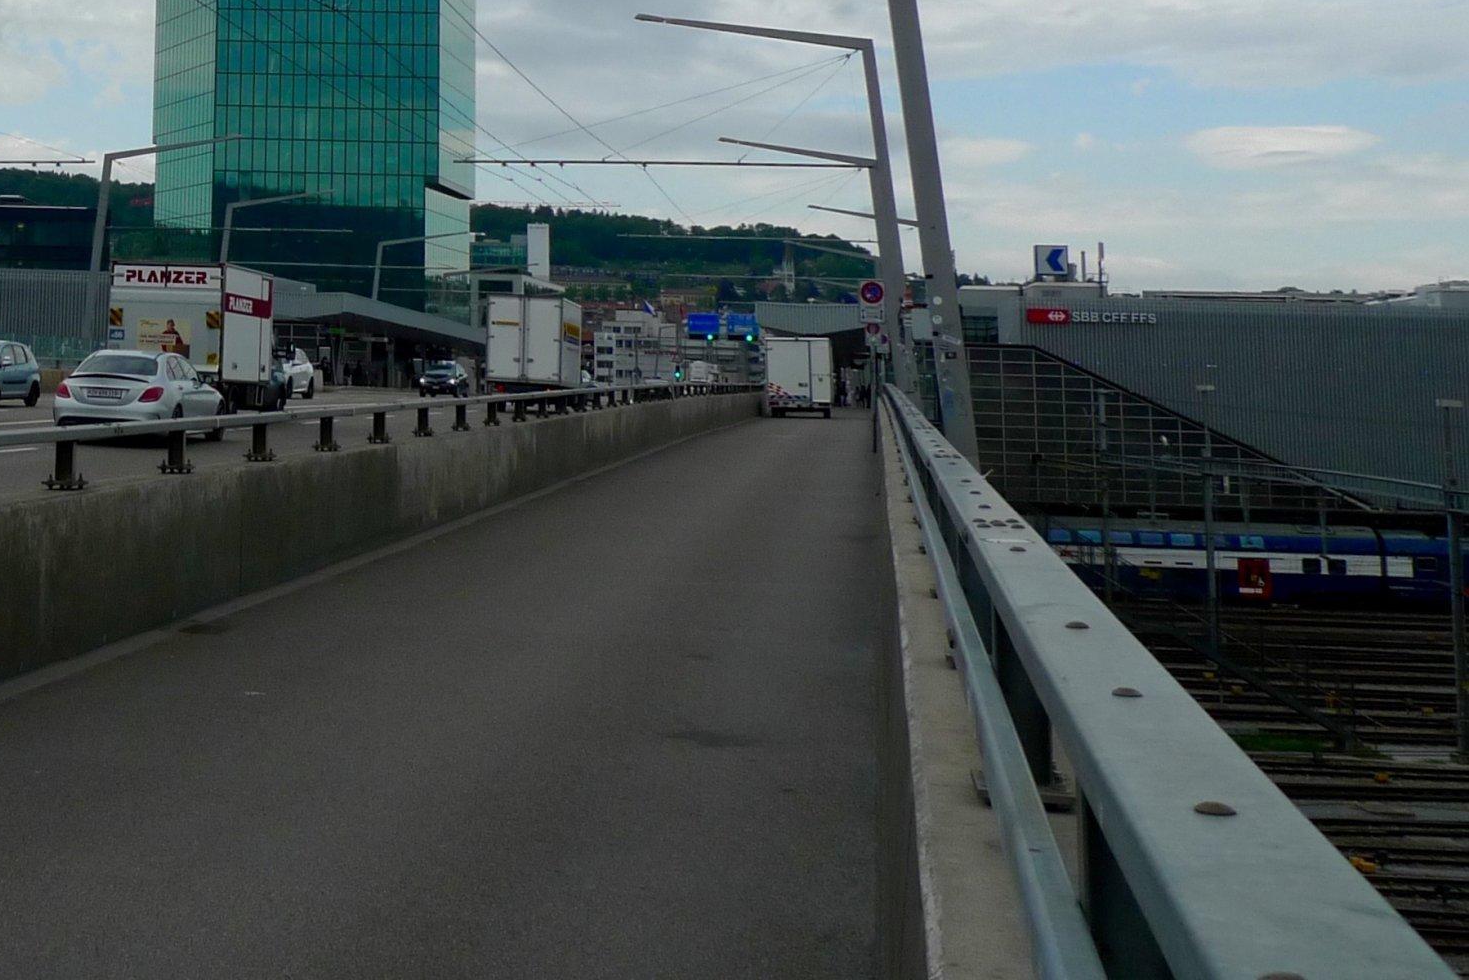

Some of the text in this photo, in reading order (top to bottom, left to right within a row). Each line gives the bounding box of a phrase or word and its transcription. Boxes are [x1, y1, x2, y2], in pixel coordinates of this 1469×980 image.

[126, 269, 208, 285] PLANZER
[1071, 311, 1157, 324] SBB CFF FFS
